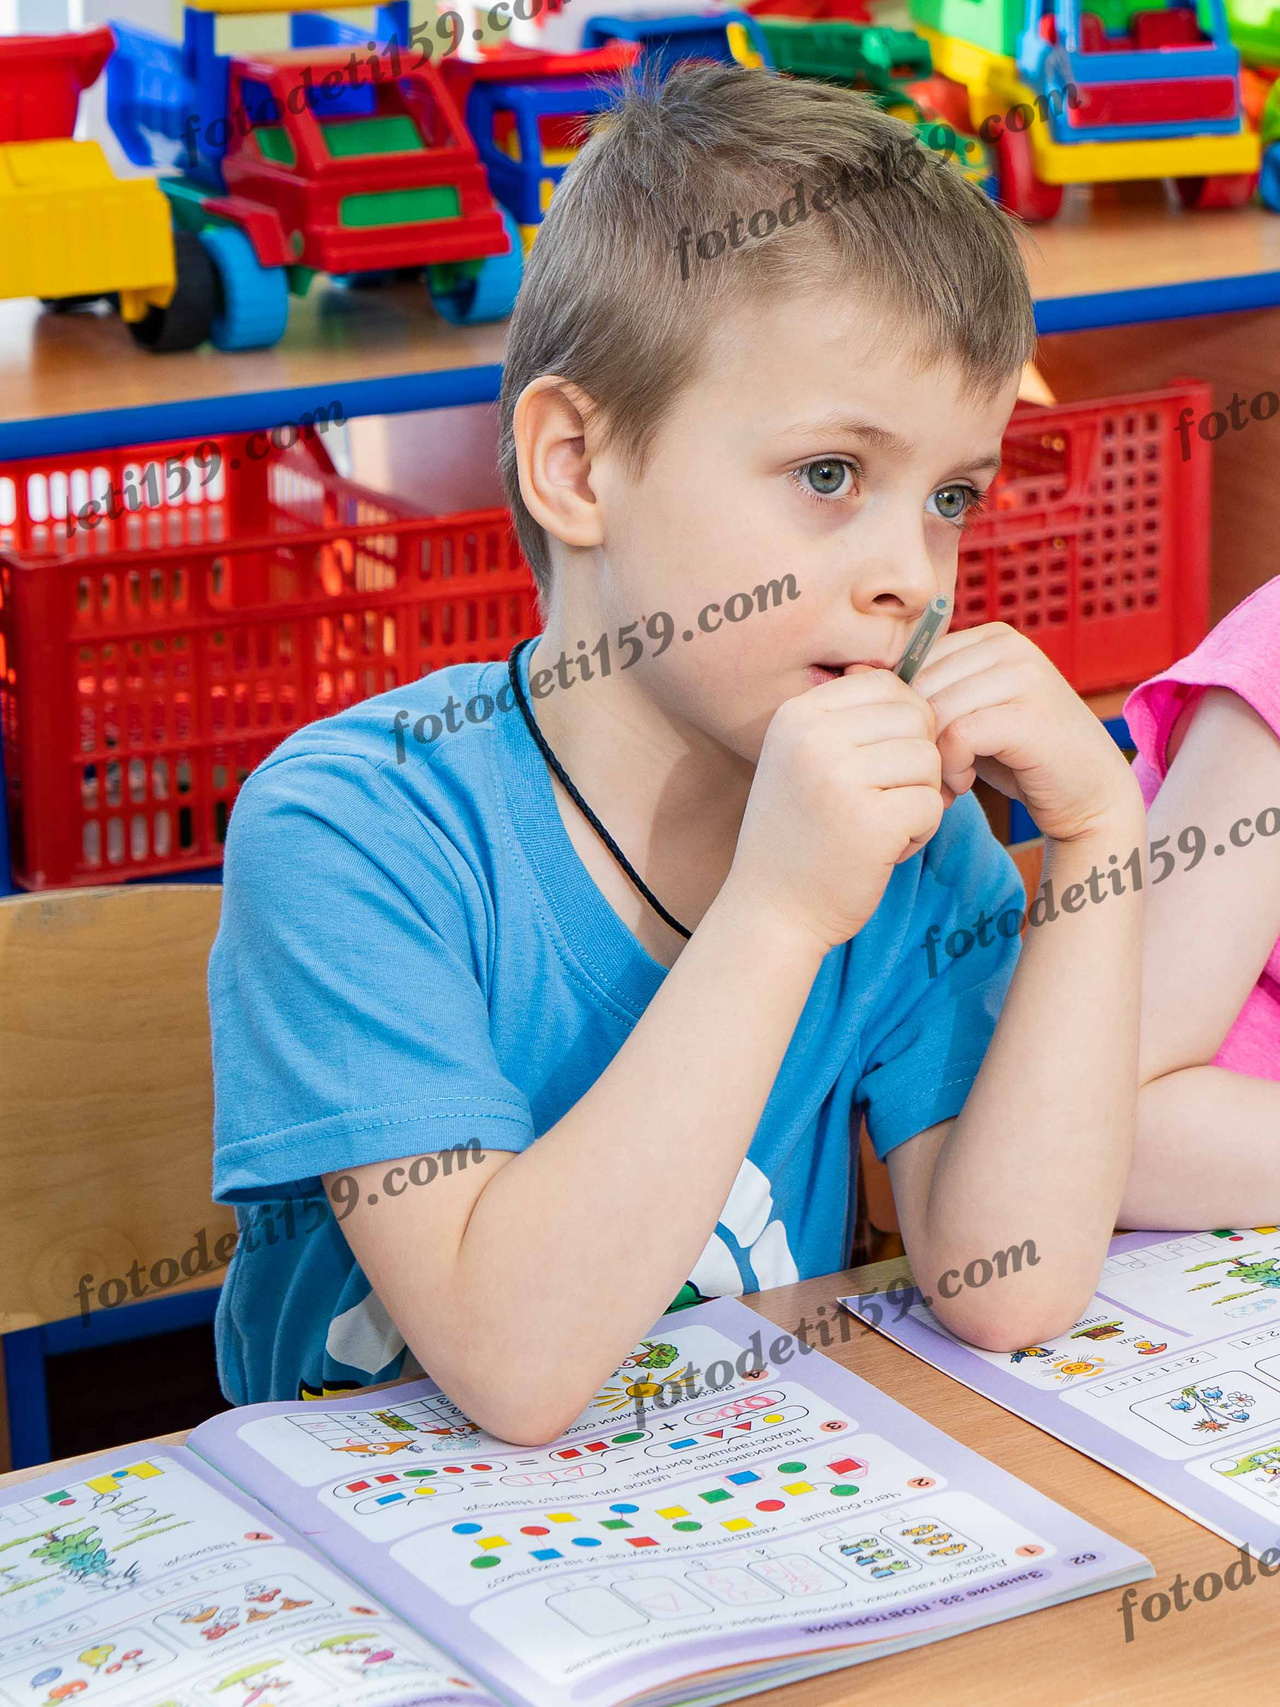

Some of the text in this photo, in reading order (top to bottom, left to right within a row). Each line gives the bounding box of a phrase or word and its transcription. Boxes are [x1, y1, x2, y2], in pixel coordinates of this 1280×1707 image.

[562, 1422, 597, 1436] сосе
[694, 1427, 802, 1463] недостающие
[780, 1434, 815, 1454] Что
[693, 1445, 775, 1473] неизвестно
[591, 1487, 621, 1498] или
[622, 1474, 672, 1491] целое
[462, 1499, 534, 1515] Нарисуй
[800, 1500, 862, 1525] больше
[863, 1491, 902, 1515] Чего
[695, 1524, 779, 1552] квадратов
[1070, 1552, 1097, 1566] 62
[938, 1560, 1008, 1586] Дорисуй
[799, 1570, 1044, 1635] Занятие 33. ПОВТОРЕНИЕ
